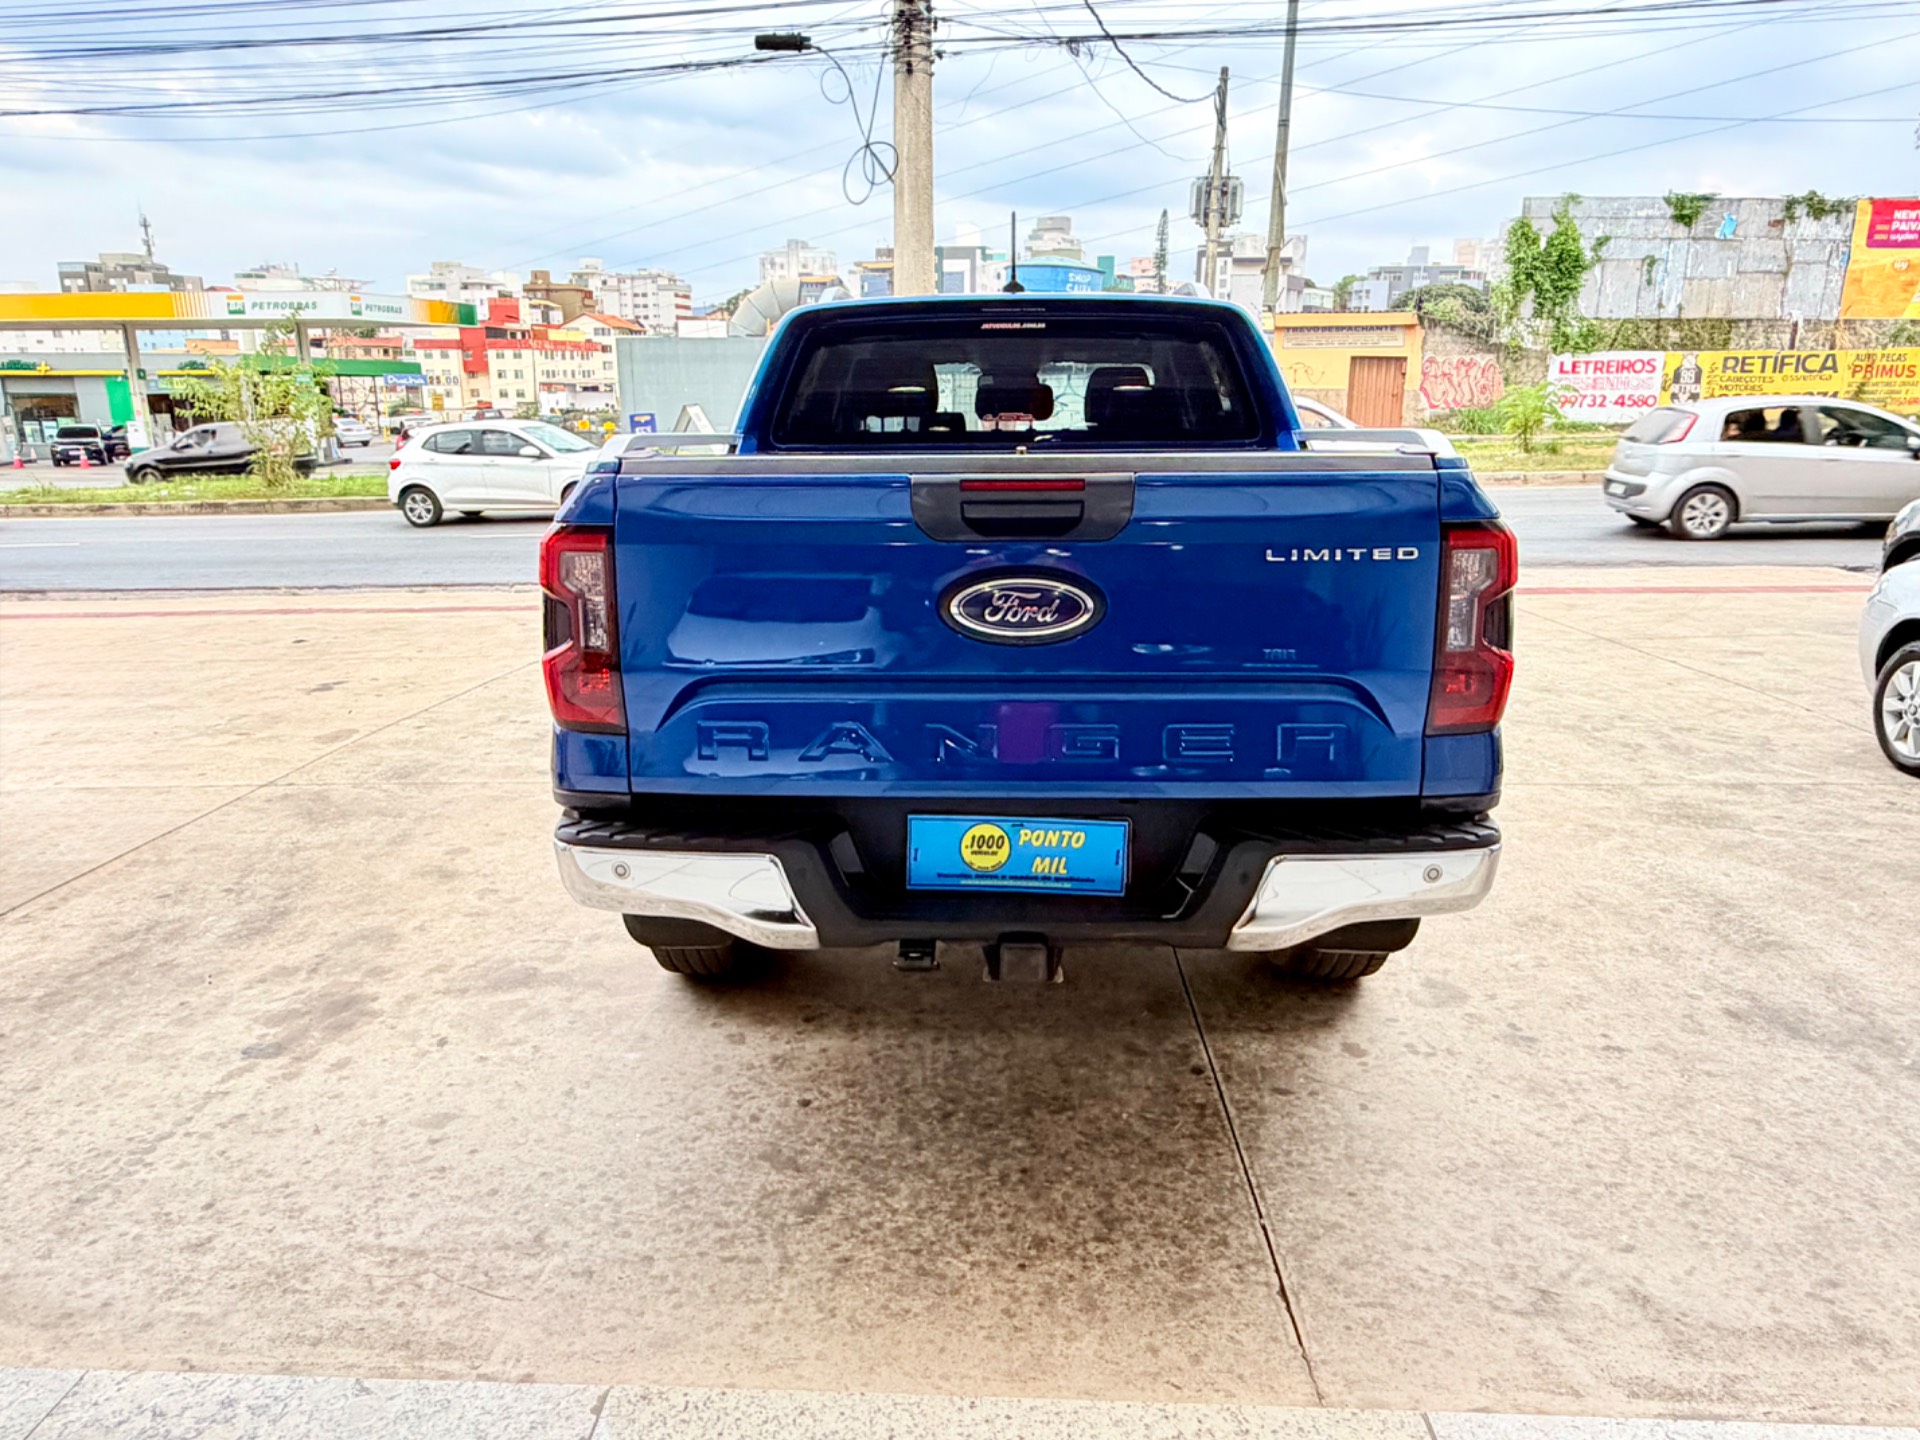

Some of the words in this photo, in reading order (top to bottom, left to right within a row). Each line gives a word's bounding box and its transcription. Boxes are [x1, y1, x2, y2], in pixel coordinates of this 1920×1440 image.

[251, 301, 318, 310] PETROBRAS
[364, 304, 402, 314] PETROBRAS
[1321, 324, 1397, 333] DESPACHANTE
[1721, 352, 1839, 374] RETÍFICA
[1854, 353, 1878, 362] AUTO
[1559, 358, 1657, 375] LETREIROS
[1851, 363, 1917, 379] PRIMUS
[387, 374, 426, 385] Ducha
[1719, 383, 1764, 392] MOTORES
[1559, 394, 1657, 408] 99732-4580
[1265, 547, 1419, 562] LIMITED
[984, 591, 1059, 623] Ford
[697, 720, 1347, 762] RANGER
[1018, 828, 1086, 849] PONTO
[1031, 856, 1068, 875] MIL
